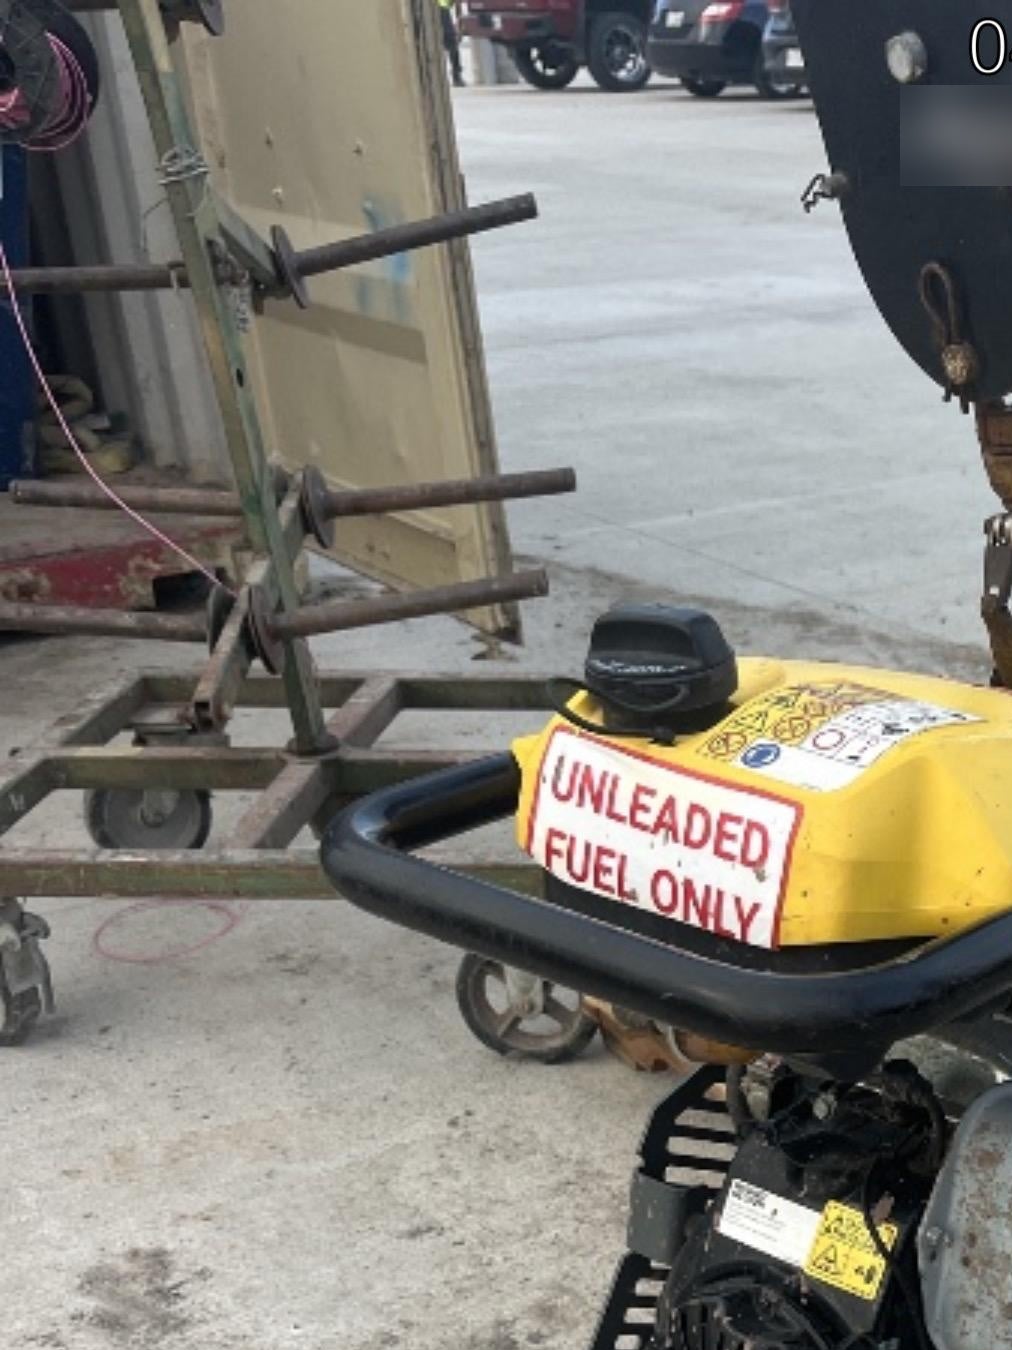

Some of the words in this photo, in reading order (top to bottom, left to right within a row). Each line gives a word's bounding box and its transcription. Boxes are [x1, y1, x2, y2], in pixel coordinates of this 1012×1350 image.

[551, 755, 771, 869] UNLEADED
[545, 827, 637, 901] FUEL
[650, 869, 762, 944] ONLY
